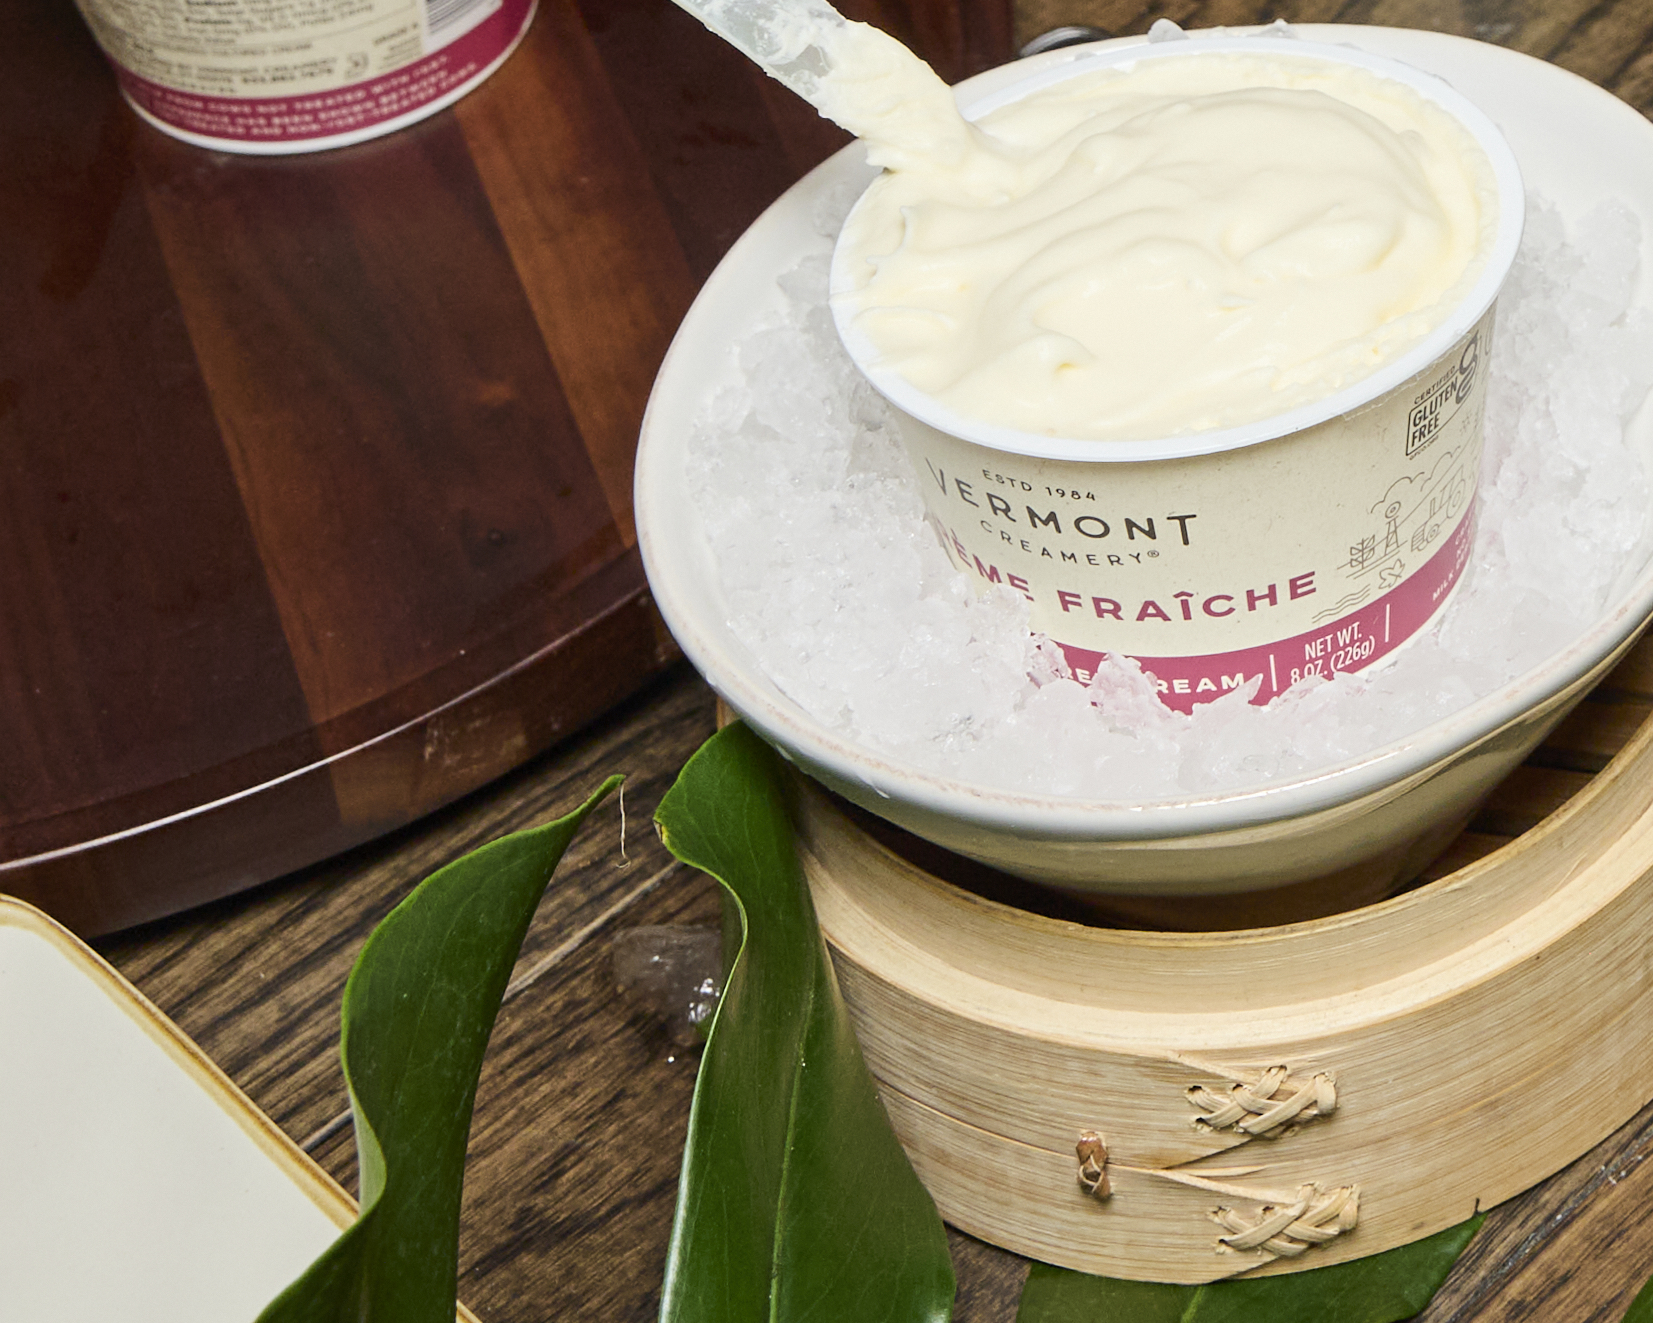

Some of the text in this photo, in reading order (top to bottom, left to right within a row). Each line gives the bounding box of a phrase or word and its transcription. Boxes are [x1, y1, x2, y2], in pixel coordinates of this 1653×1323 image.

[1412, 375, 1459, 428] GLUTEN
[1411, 411, 1440, 448] FREE
[925, 457, 1198, 546] VERMONT
[982, 468, 1096, 502] ESTD 1984
[1056, 571, 1318, 622] FRAÎCHE
[1290, 668, 1302, 686] 8
[1329, 635, 1377, 674] (226g)
[1303, 621, 1363, 661] NET WT.
